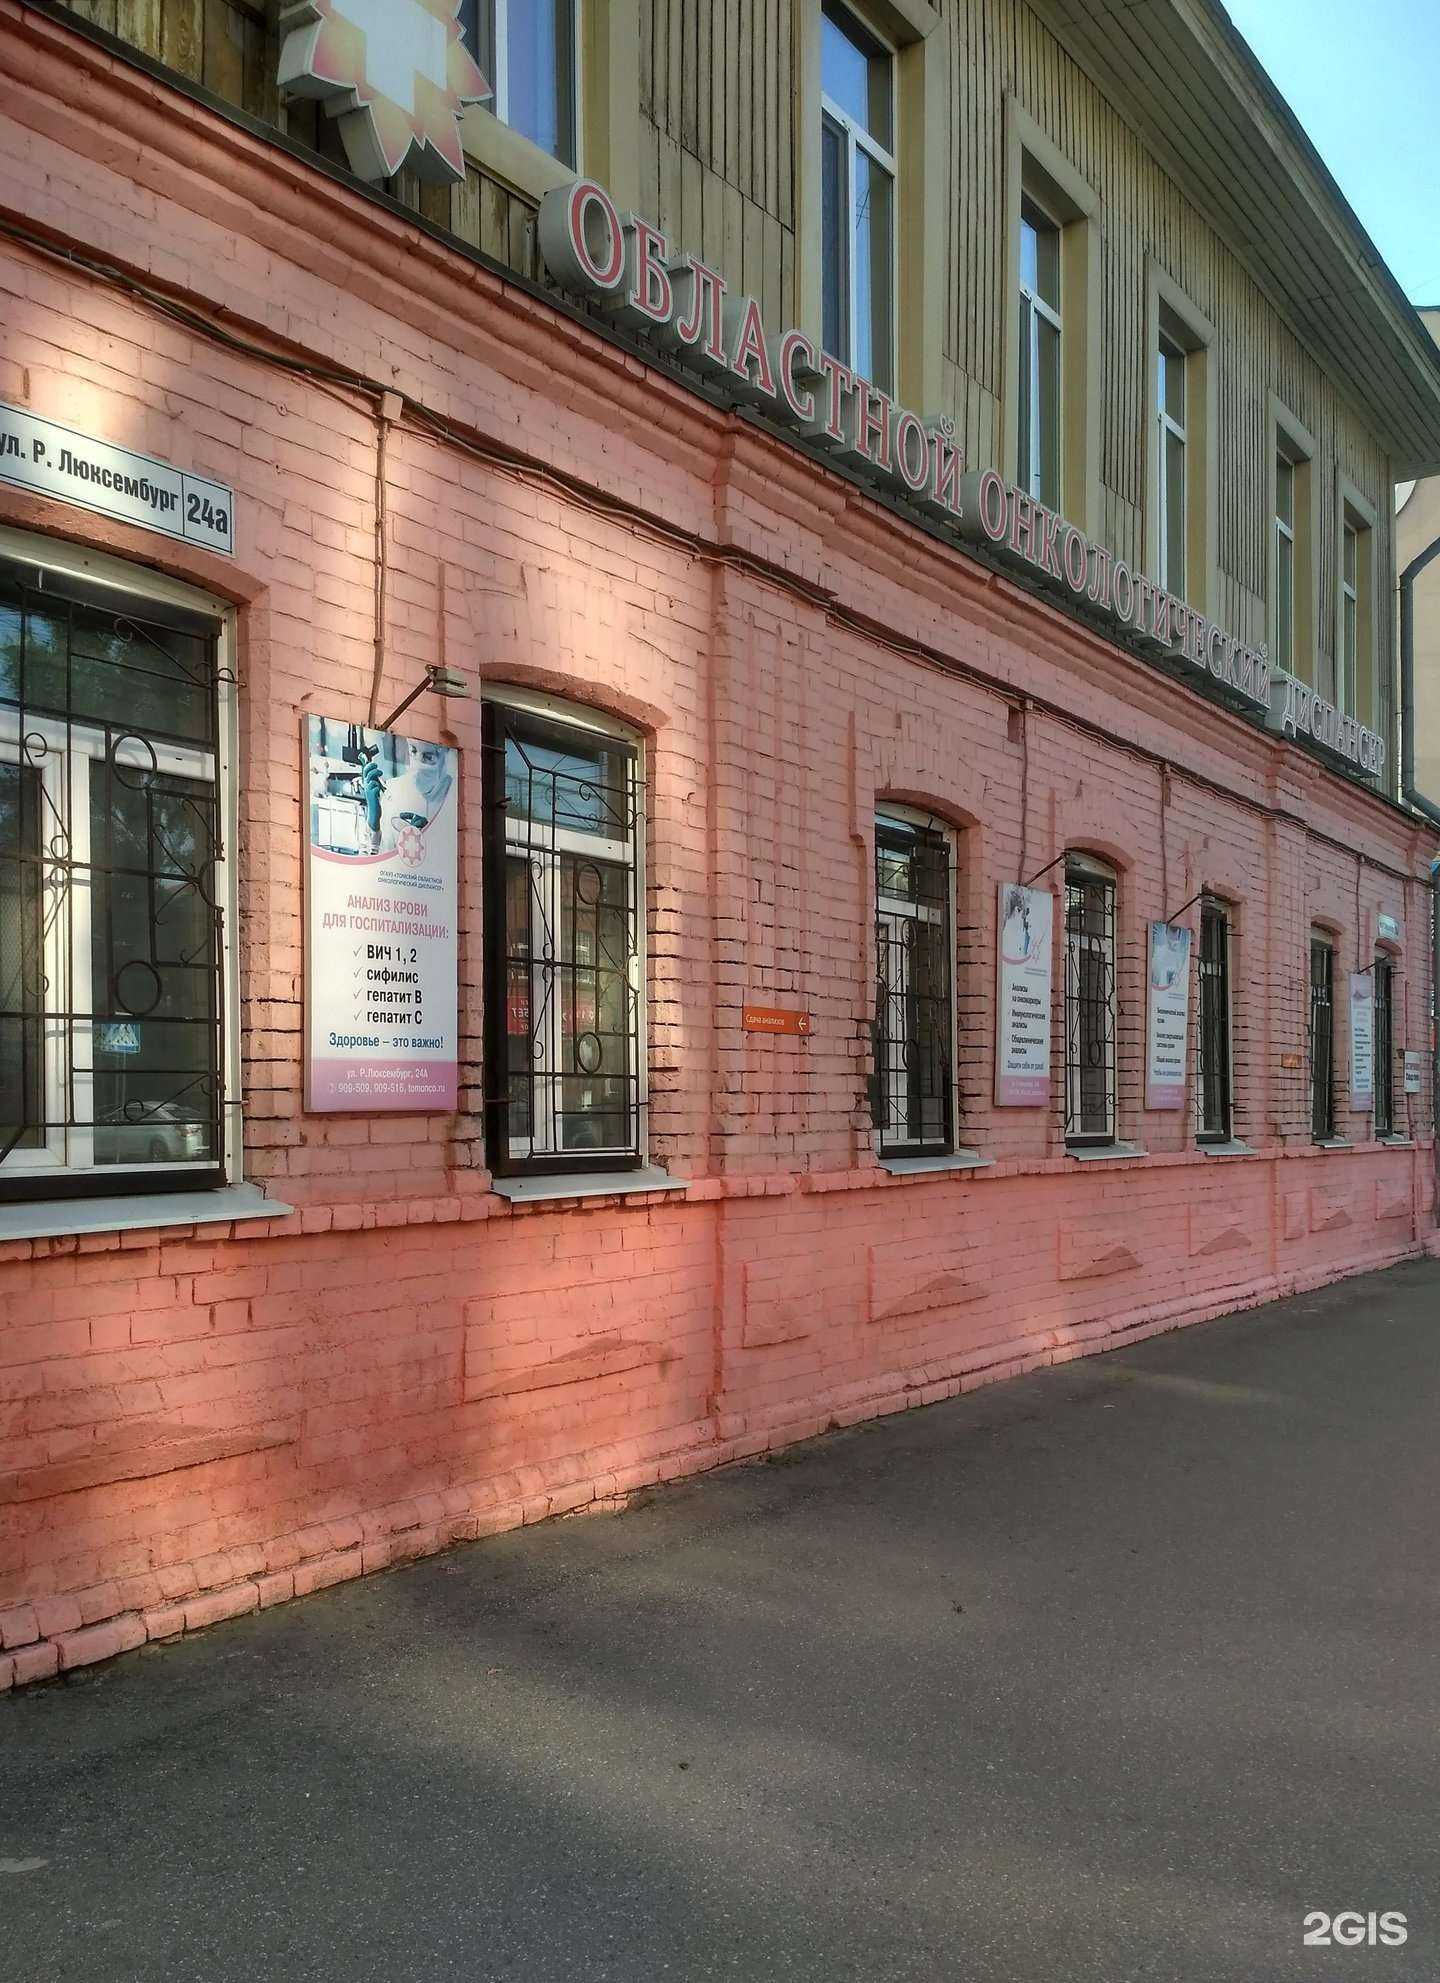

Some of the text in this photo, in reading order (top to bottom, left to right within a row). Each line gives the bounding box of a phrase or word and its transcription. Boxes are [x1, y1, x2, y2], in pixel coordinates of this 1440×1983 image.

[33, 438, 52, 468] Р.
[58, 448, 179, 512] Люксембург
[186, 492, 228, 535] 24а
[566, 180, 1386, 780] ОБЛАСТНОЙ ОНКОЛОГИЧЕСКИЙ ДИСПАНСЕР
[347, 895, 428, 917] АНАЛИЗ КРОВИ
[322, 912, 449, 940] ДЛЯ ГОСПИТАЛИЗАЦИИ:
[367, 944, 392, 961] ВИЧ
[410, 948, 417, 963] 2
[366, 967, 419, 984] сифилис
[367, 990, 412, 1004] гепатит
[367, 1010, 412, 1024] гепатит
[329, 1032, 380, 1049] Здоровье
[392, 1037, 409, 1048] это
[411, 1036, 444, 1049] важно!
